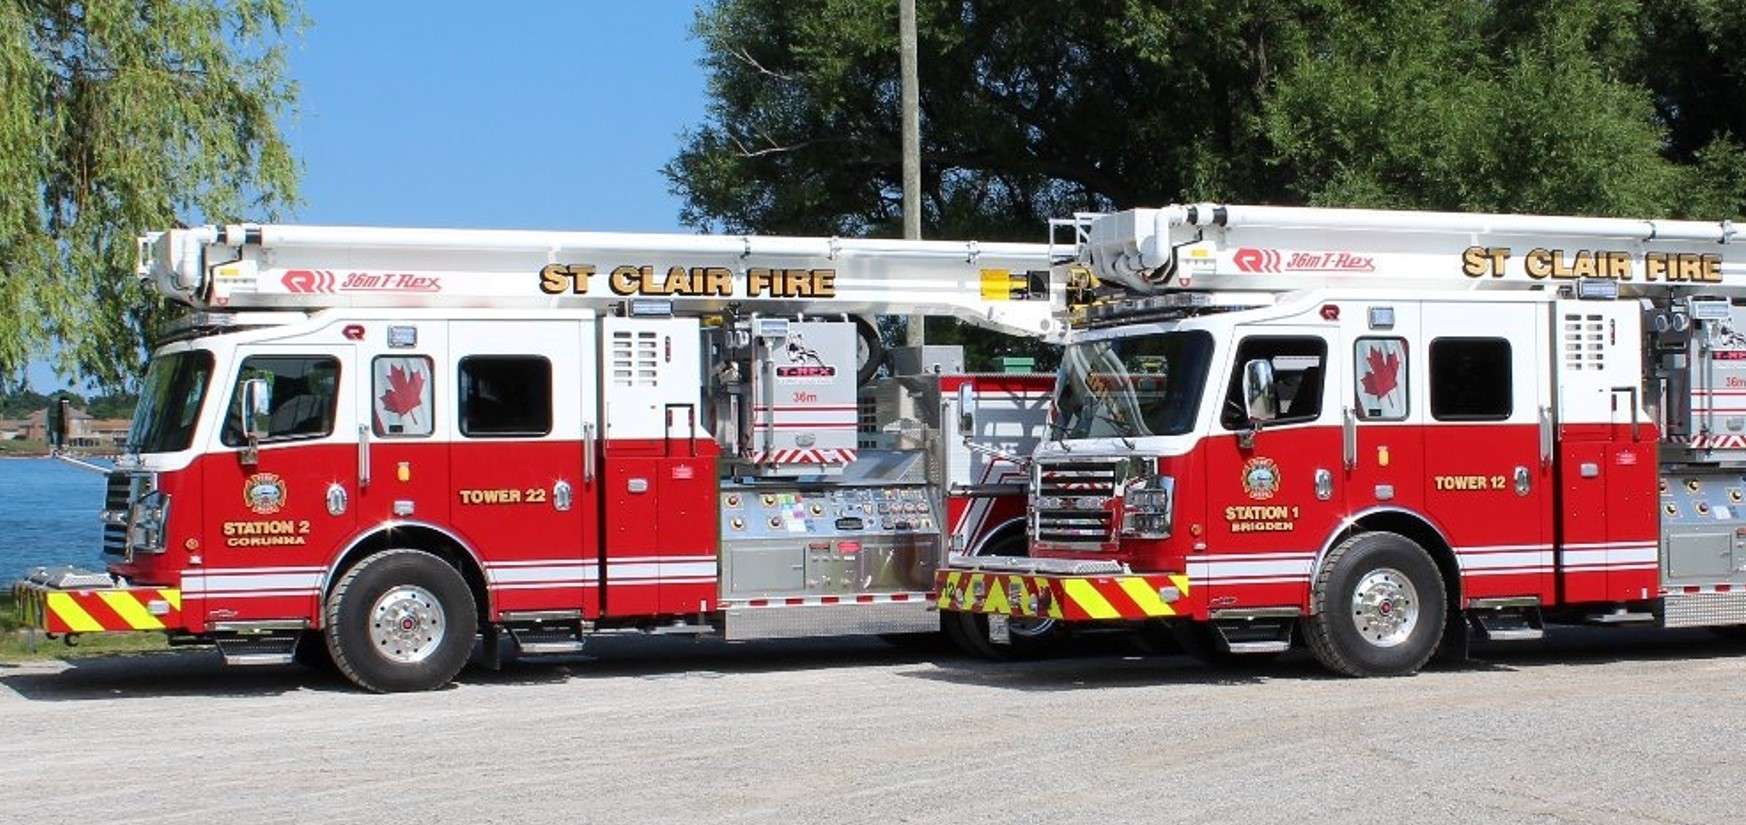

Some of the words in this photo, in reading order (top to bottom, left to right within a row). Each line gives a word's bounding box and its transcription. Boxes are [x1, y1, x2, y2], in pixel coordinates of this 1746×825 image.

[1286, 252, 1322, 268] 36m
[1321, 253, 1376, 272] T-Rex
[1462, 246, 1511, 277] ST
[1524, 248, 1633, 279] CLAIR
[1645, 251, 1723, 282] FIRE
[341, 272, 381, 288] 36m
[380, 273, 442, 289] T-Rex
[539, 263, 596, 294] ST
[609, 265, 734, 296] CLAIR
[746, 268, 836, 298] FIRE
[780, 367, 831, 377] T-REX
[793, 391, 817, 402] 36m
[1434, 475, 1488, 491] TOWER
[1489, 475, 1507, 489] 12
[458, 489, 521, 504] TOWER
[522, 487, 547, 503] 22
[1224, 505, 1289, 521] STATION
[1291, 505, 1300, 519] 1
[222, 520, 295, 536] STATION
[298, 520, 311, 534] 2
[1231, 521, 1294, 533] BRIGDEN
